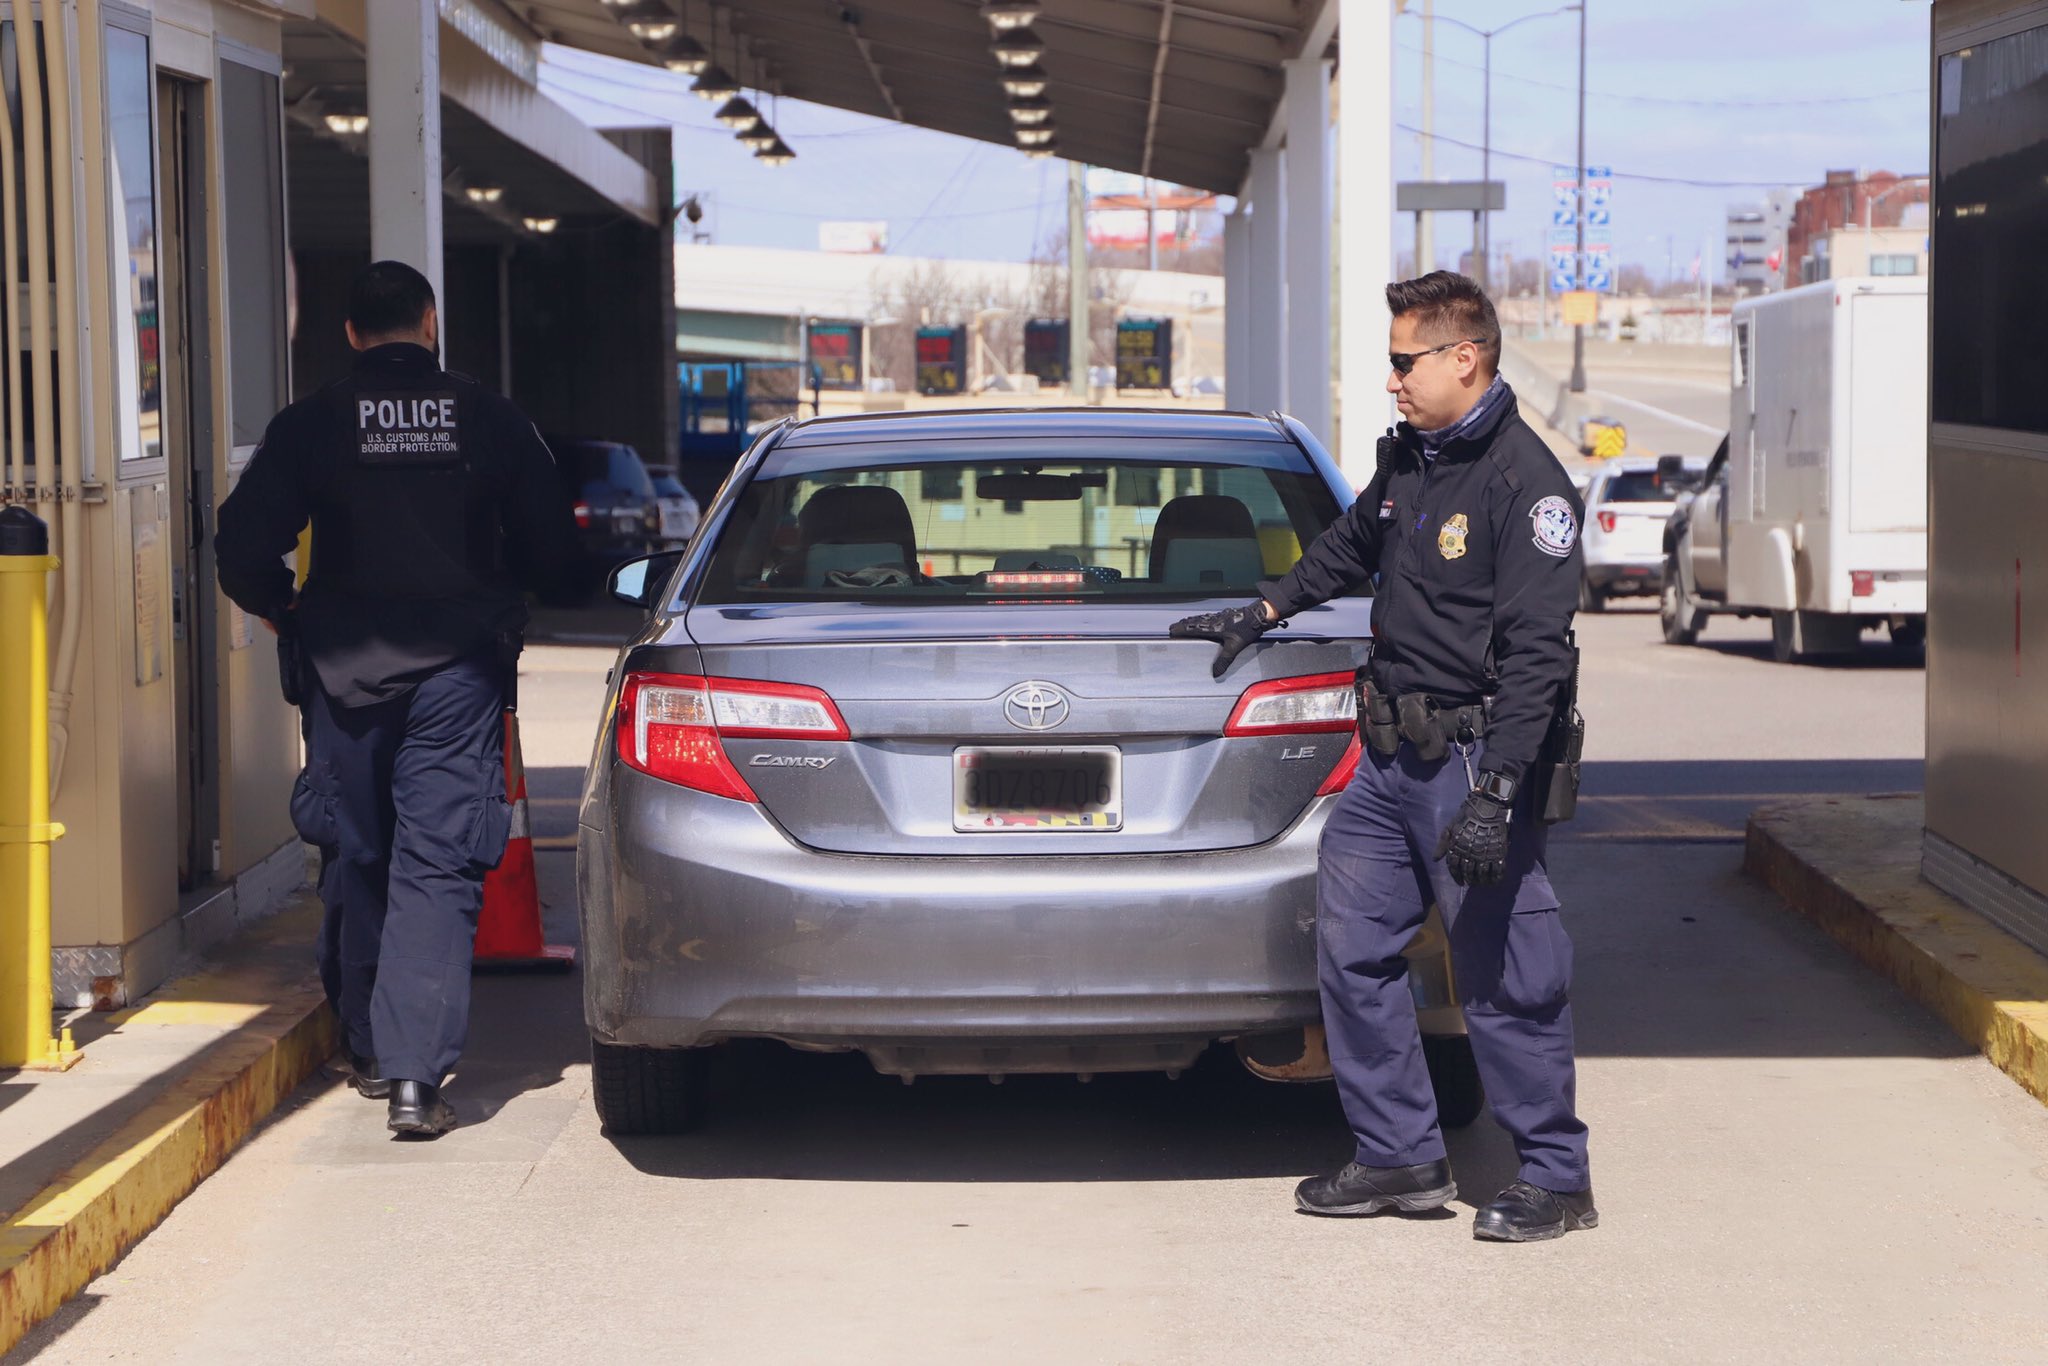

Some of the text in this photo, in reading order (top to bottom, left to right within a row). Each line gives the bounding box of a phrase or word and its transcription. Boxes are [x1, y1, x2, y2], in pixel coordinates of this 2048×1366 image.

[359, 399, 456, 429] POLICE
[367, 432, 450, 443] U.S. CUSTOMS AND
[361, 442, 457, 453] BORDER PROTECTION
[1281, 746, 1317, 761] LE
[749, 754, 836, 770] CAMRY
